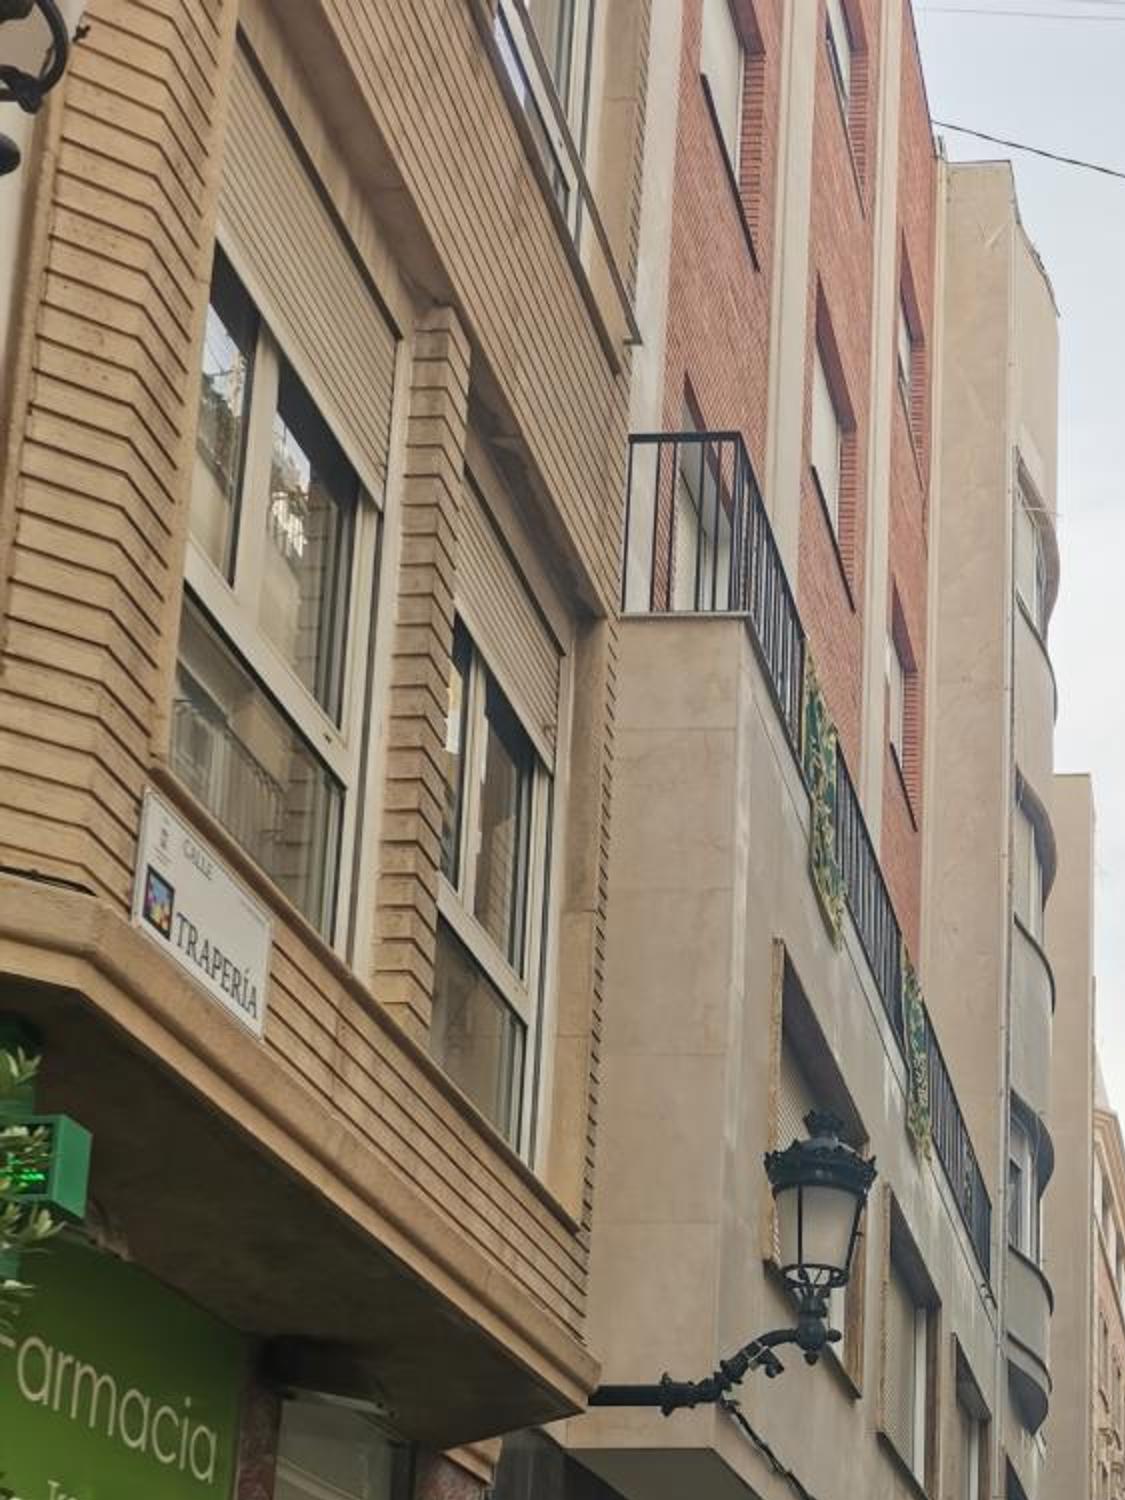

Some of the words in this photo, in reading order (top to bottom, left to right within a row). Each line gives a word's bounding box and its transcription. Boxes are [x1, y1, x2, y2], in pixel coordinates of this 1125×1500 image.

[182, 838, 214, 881] CALLE
[176, 911, 258, 1020] TRAPERÍA
[0, 1334, 217, 1485] armacia
